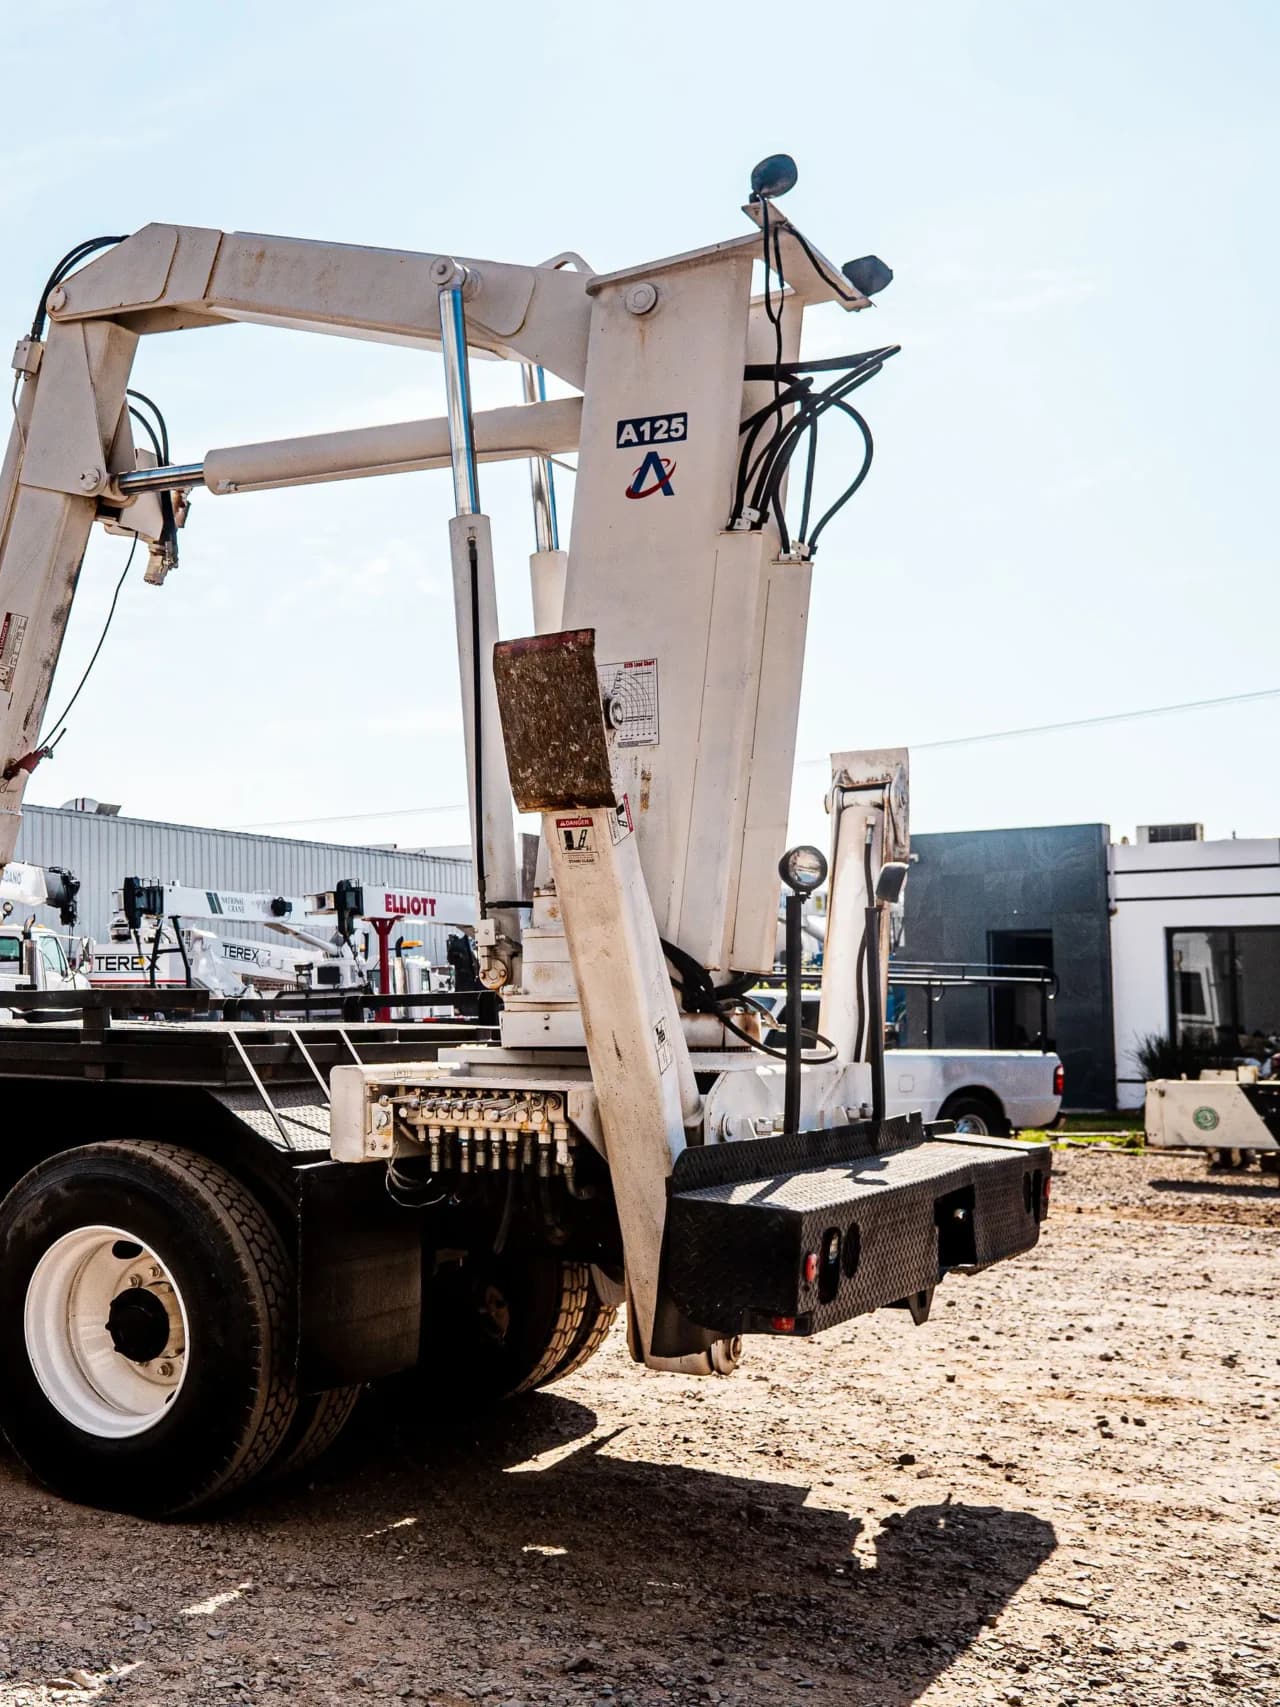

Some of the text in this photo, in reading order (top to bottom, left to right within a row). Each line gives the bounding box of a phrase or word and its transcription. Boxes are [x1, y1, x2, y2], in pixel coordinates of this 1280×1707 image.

[619, 417, 685, 445] A125
[566, 819, 590, 828] DANGER
[384, 893, 436, 917] ELLIOTT
[222, 944, 260, 961] TEREX
[95, 956, 160, 971] TEREX
